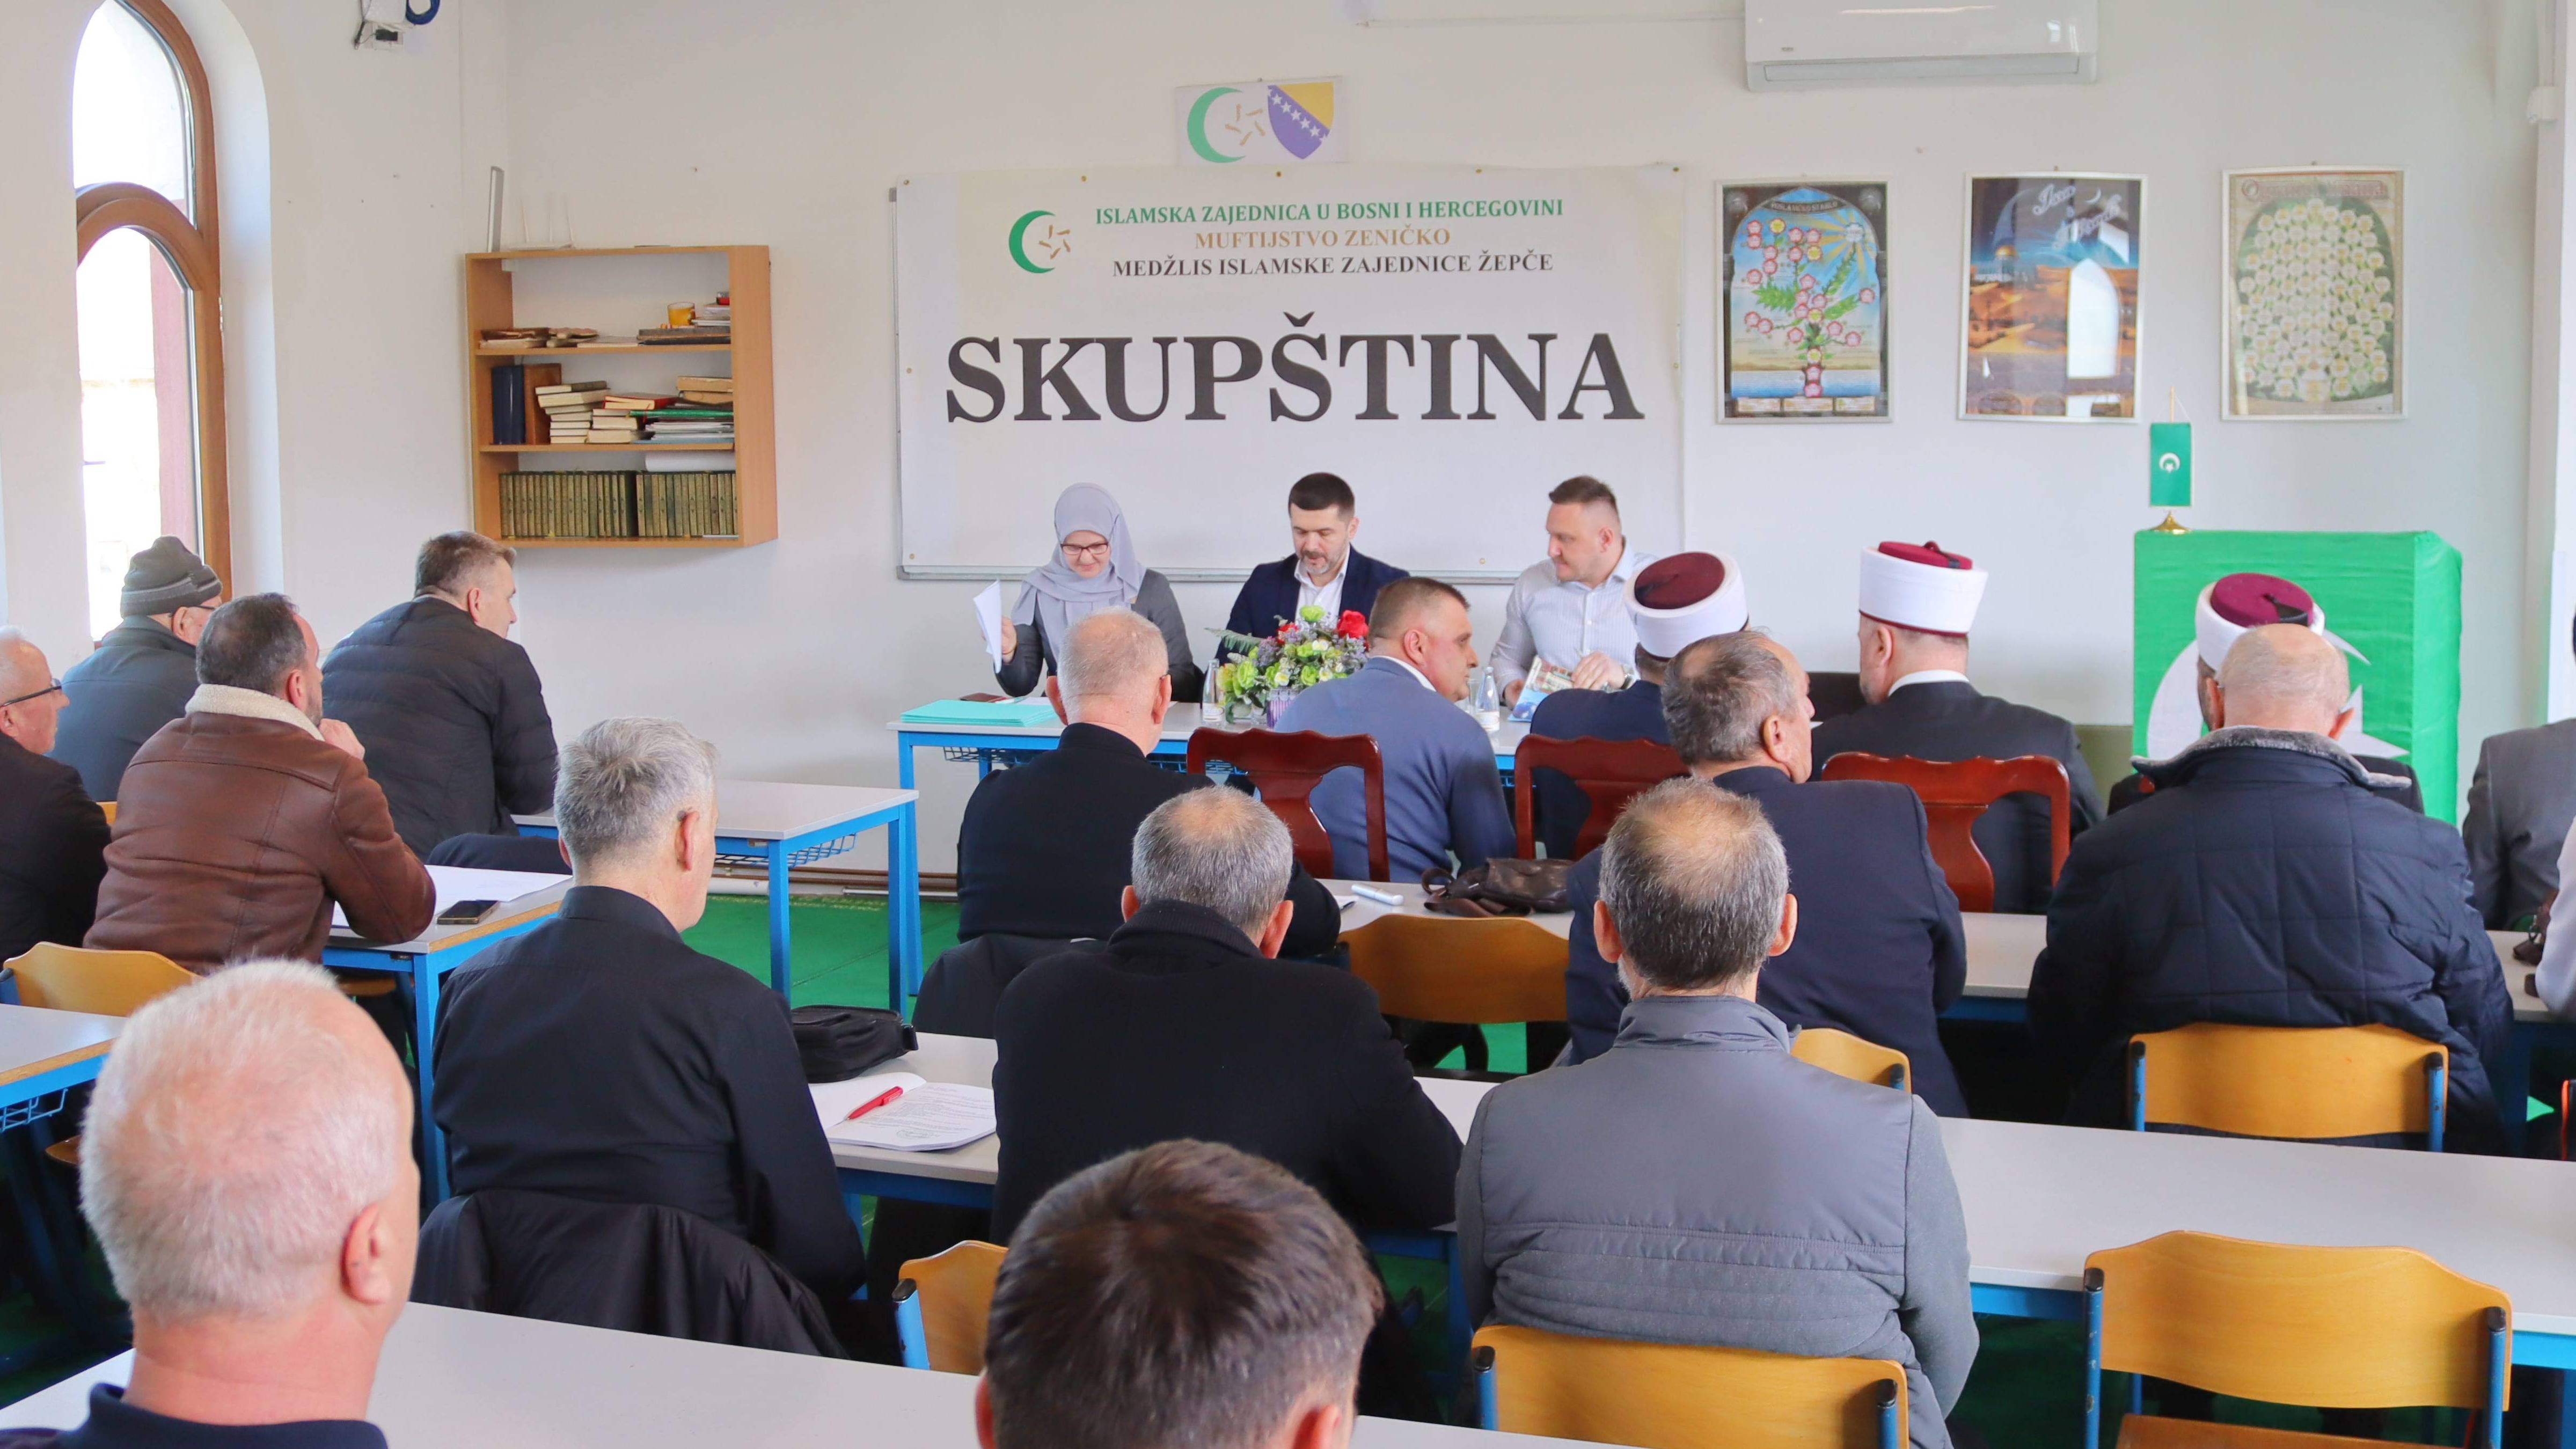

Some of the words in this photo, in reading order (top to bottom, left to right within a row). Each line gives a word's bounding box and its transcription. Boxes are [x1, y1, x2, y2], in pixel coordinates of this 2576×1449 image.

[1096, 207, 1197, 224] ISLAMSKA
[1202, 205, 1312, 225] ZAJEDNICA
[1318, 204, 1330, 221] U
[1337, 203, 1400, 220] BOSNI
[1406, 202, 1413, 219] I
[1419, 199, 1563, 219] HERCEGOVINI
[1195, 230, 1339, 250] MUFTIJSTVO
[1345, 223, 1451, 247] ZENIČKO
[1113, 254, 1213, 277] MEDŽLIS
[1219, 257, 1335, 275] ISLAMSKE
[1341, 257, 1472, 274] ZAJEDNICE
[1478, 248, 1554, 272] ŽEPČE
[946, 311, 1646, 423] SKUPŠTINA
